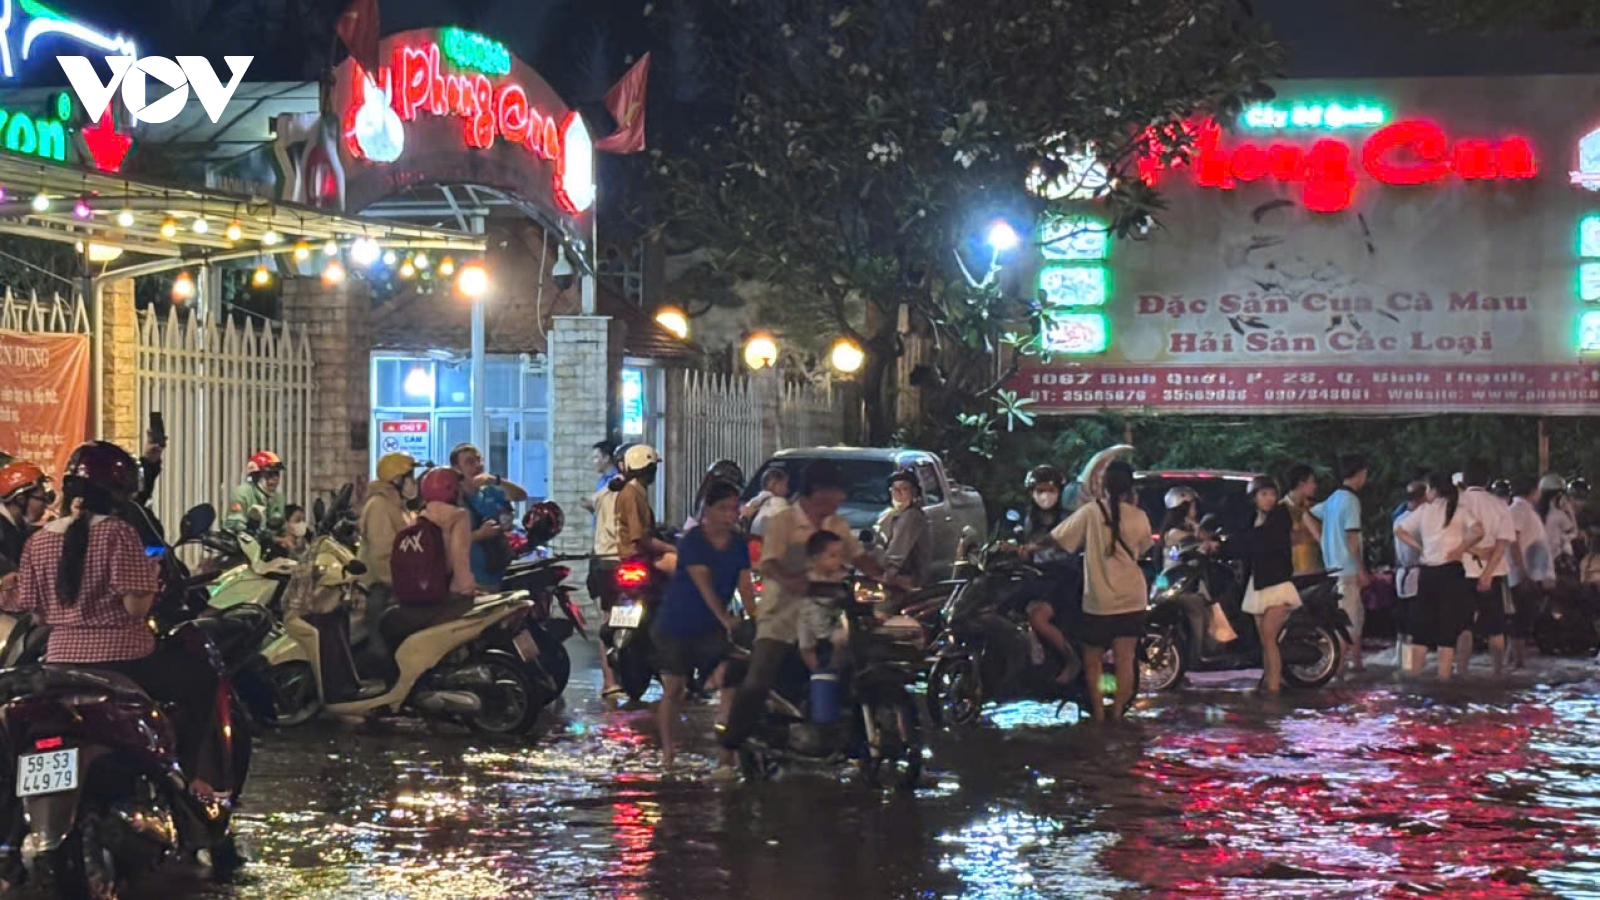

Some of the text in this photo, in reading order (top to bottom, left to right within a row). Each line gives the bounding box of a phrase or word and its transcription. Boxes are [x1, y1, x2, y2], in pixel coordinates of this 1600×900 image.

[402, 44, 494, 149] Phong
[1219, 292, 1289, 313] Sản
[1303, 293, 1373, 313] Cua
[1387, 292, 1434, 312] Cà
[1448, 291, 1527, 311] Mau
[1169, 330, 1493, 354] Hải Sản Các Loại
[1031, 373, 1093, 385] 1067
[28, 752, 69, 773] 59-S3
